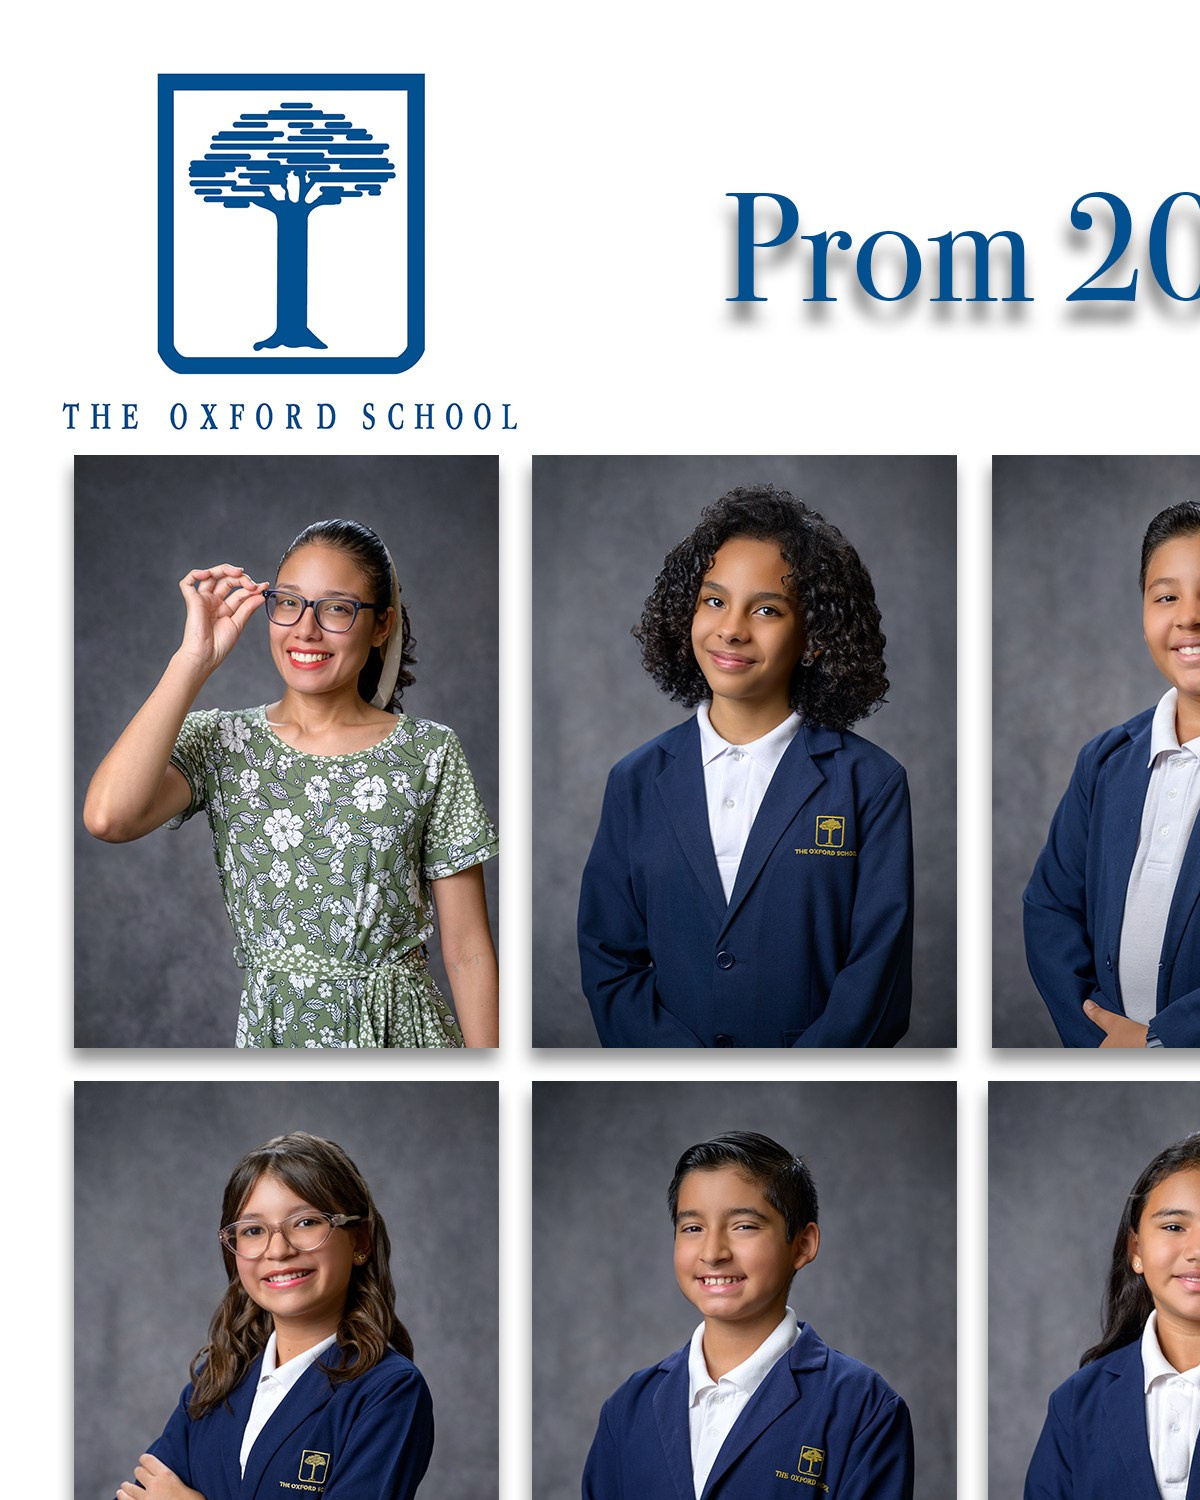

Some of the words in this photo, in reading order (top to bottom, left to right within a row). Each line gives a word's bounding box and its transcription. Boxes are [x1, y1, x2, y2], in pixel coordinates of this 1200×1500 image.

[809, 849, 835, 857] OXFORD
[775, 1470, 788, 1479] THE
[790, 1474, 816, 1486] OXFORD
[291, 1484, 316, 1492] OXFORD
